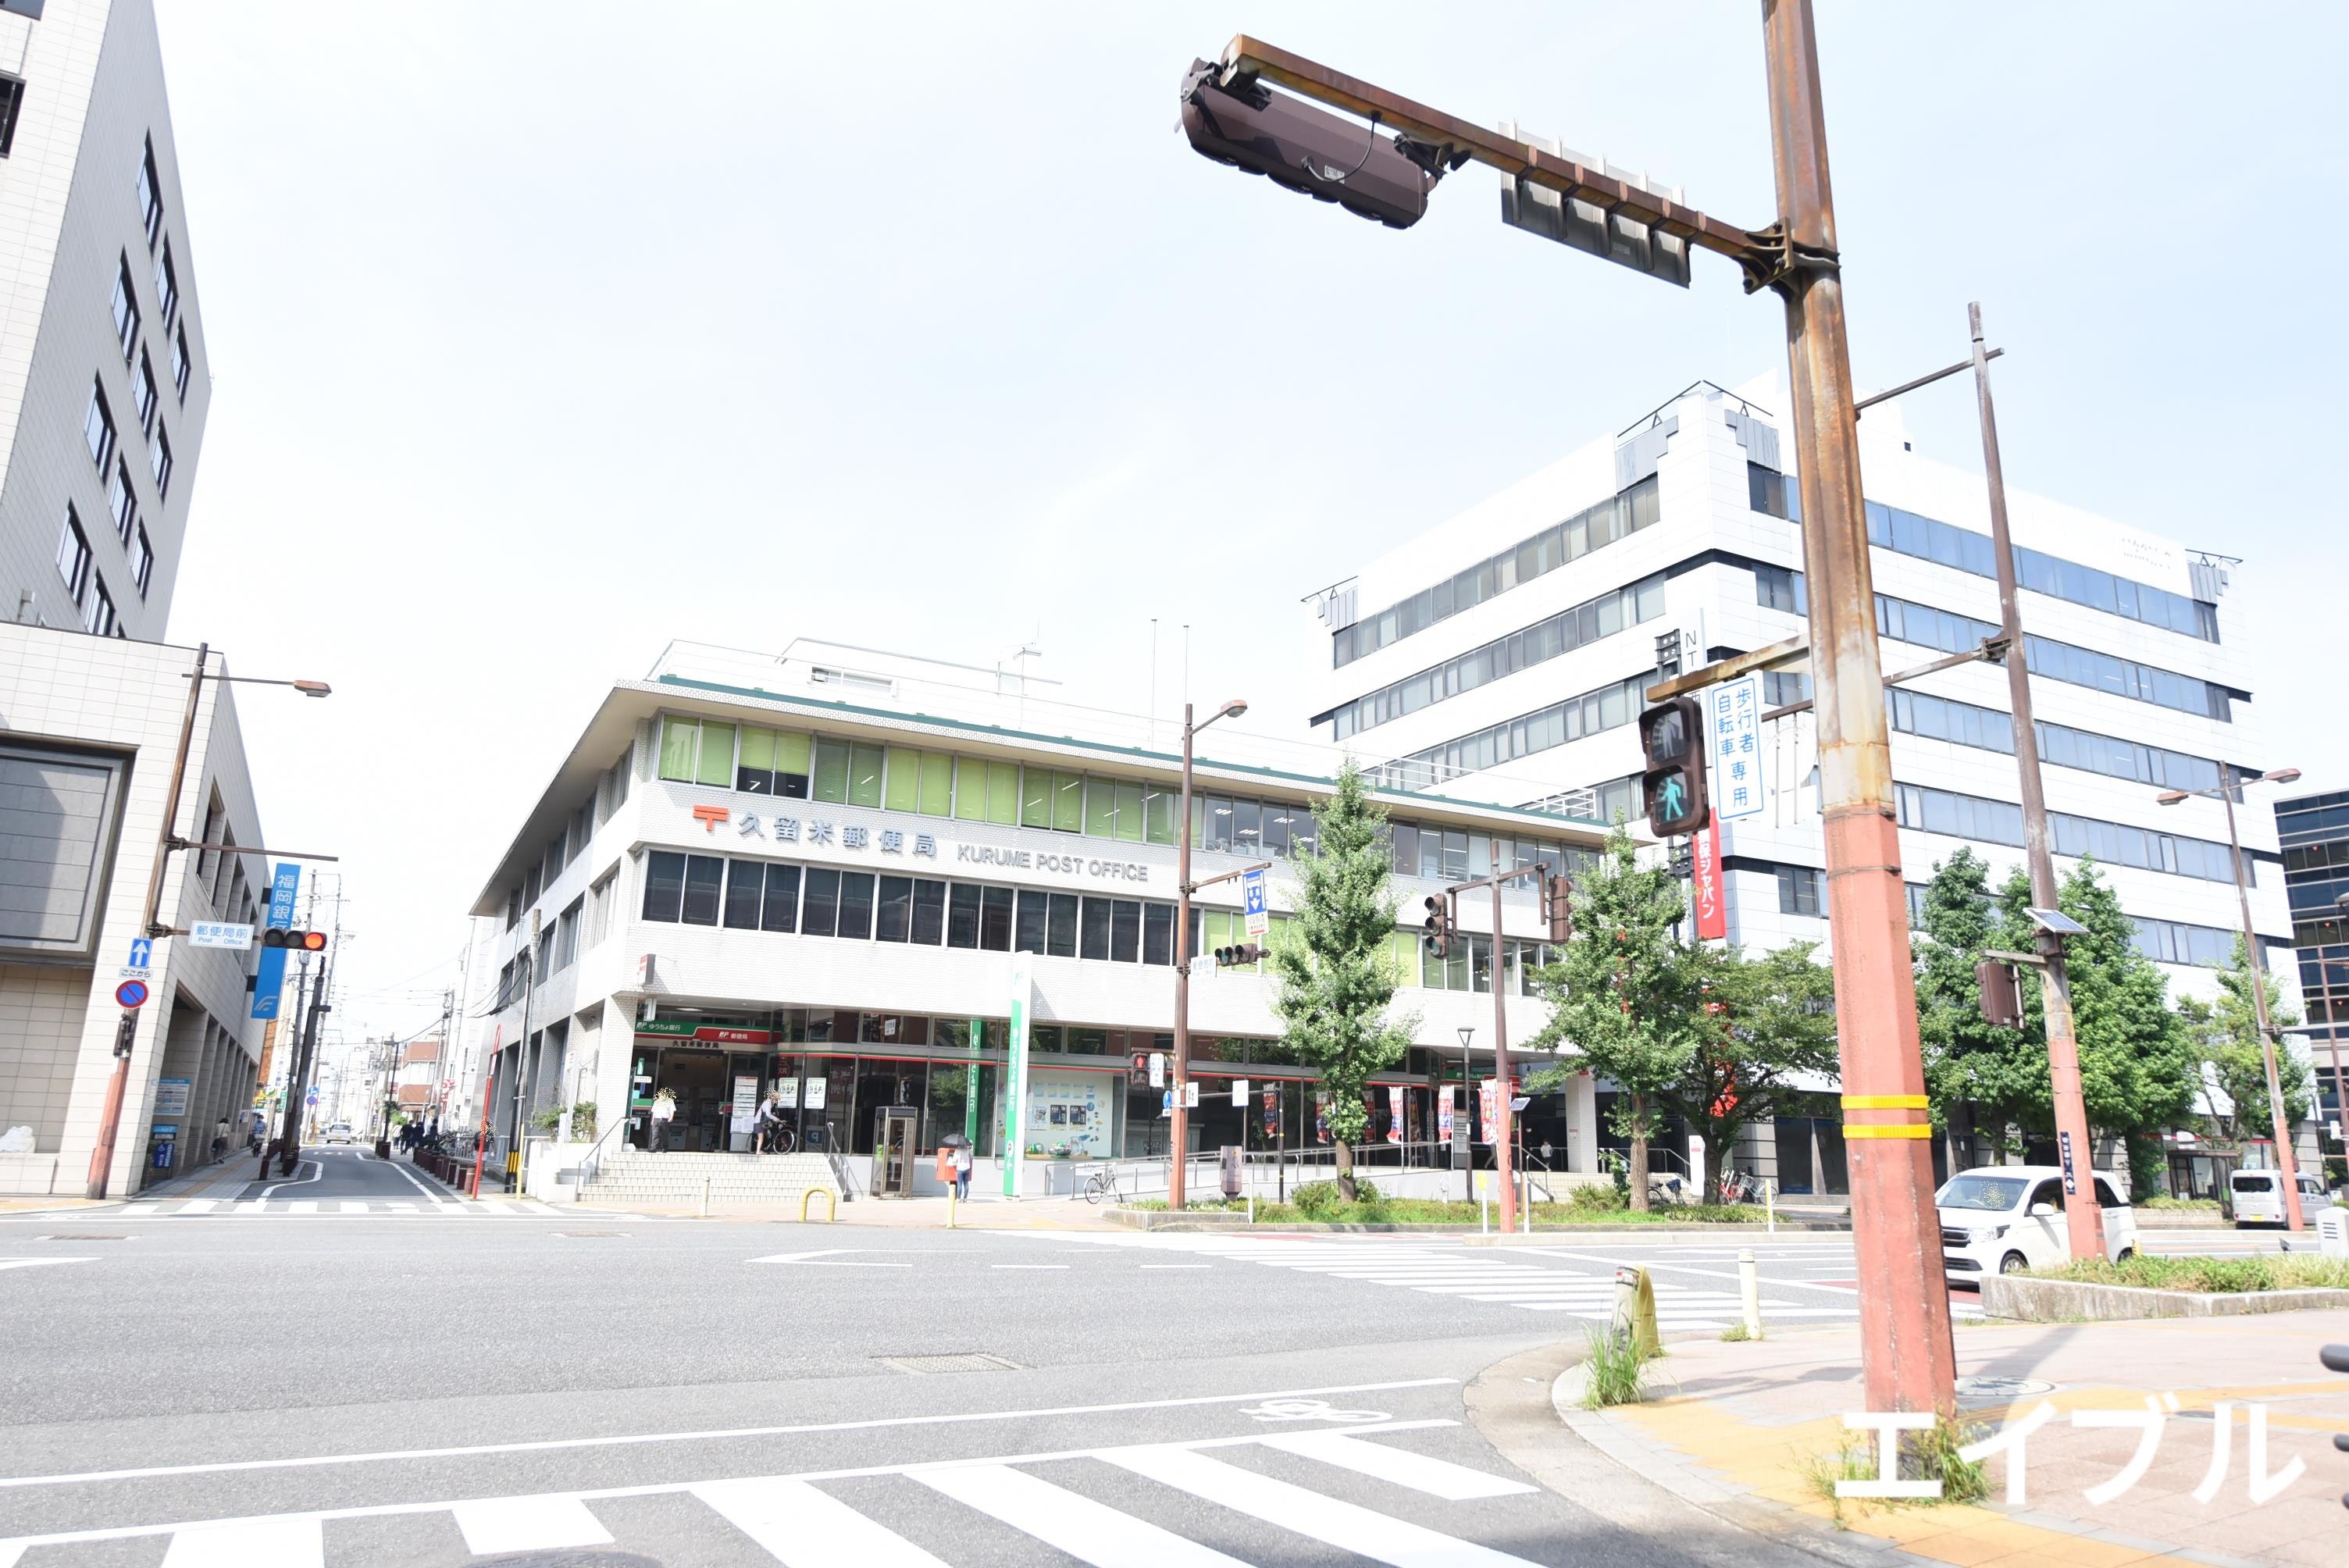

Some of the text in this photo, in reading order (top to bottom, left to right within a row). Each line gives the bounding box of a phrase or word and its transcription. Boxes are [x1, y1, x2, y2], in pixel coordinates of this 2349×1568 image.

[1718, 693, 1735, 757] 自転車
[1735, 687, 1755, 754] 歩行者
[1731, 761, 1748, 808] 専用
[737, 811, 937, 857] 久留米郵便局
[957, 843, 1149, 882] KURUME POST OFFICE
[195, 925, 248, 939] 郵便局前
[121, 968, 151, 978] ここから
[649, 1023, 681, 1032] ゆうちょ銀行
